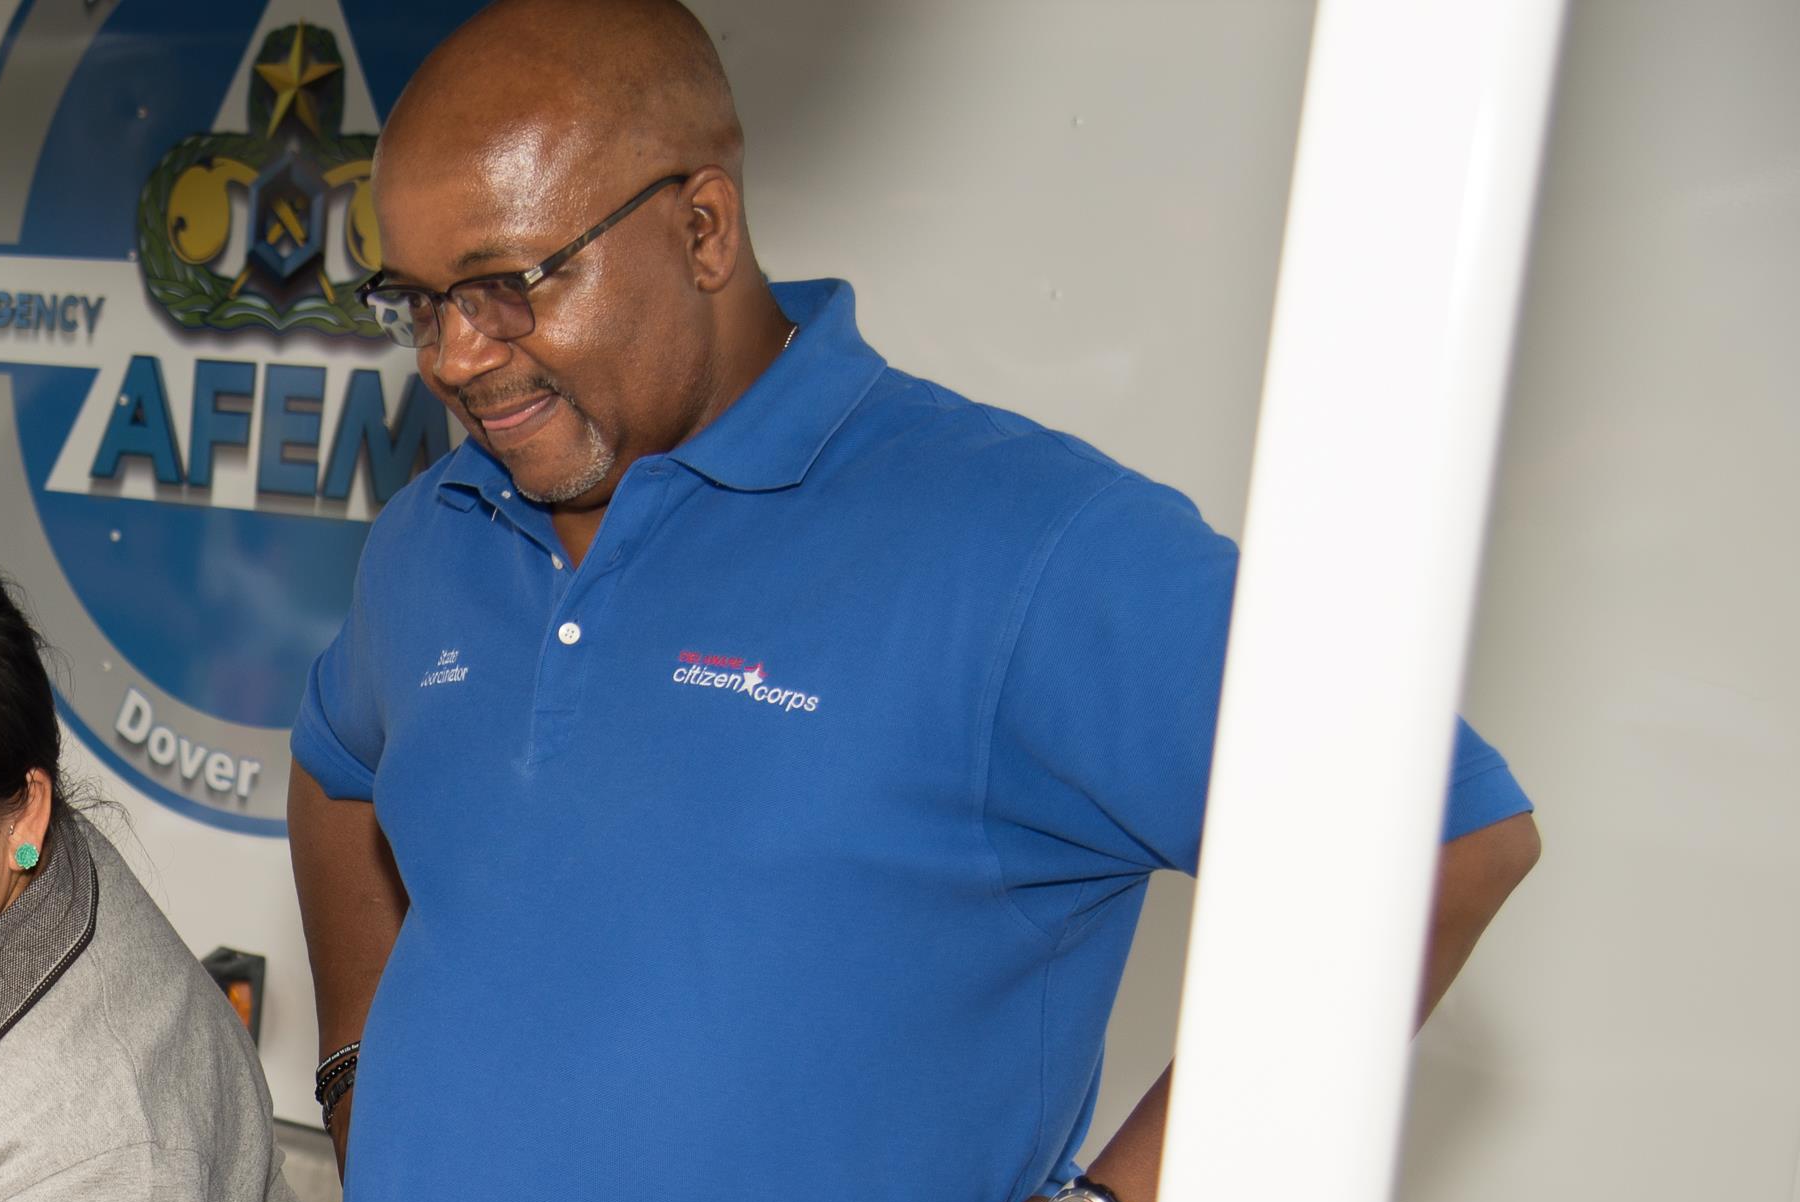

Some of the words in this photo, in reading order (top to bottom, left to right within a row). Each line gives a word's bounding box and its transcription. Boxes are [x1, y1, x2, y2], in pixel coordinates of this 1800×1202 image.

[89, 353, 452, 507] AFEM
[436, 648, 460, 667] State
[672, 664, 742, 693] citizen
[754, 683, 820, 713] corps
[114, 686, 262, 800] Dover
